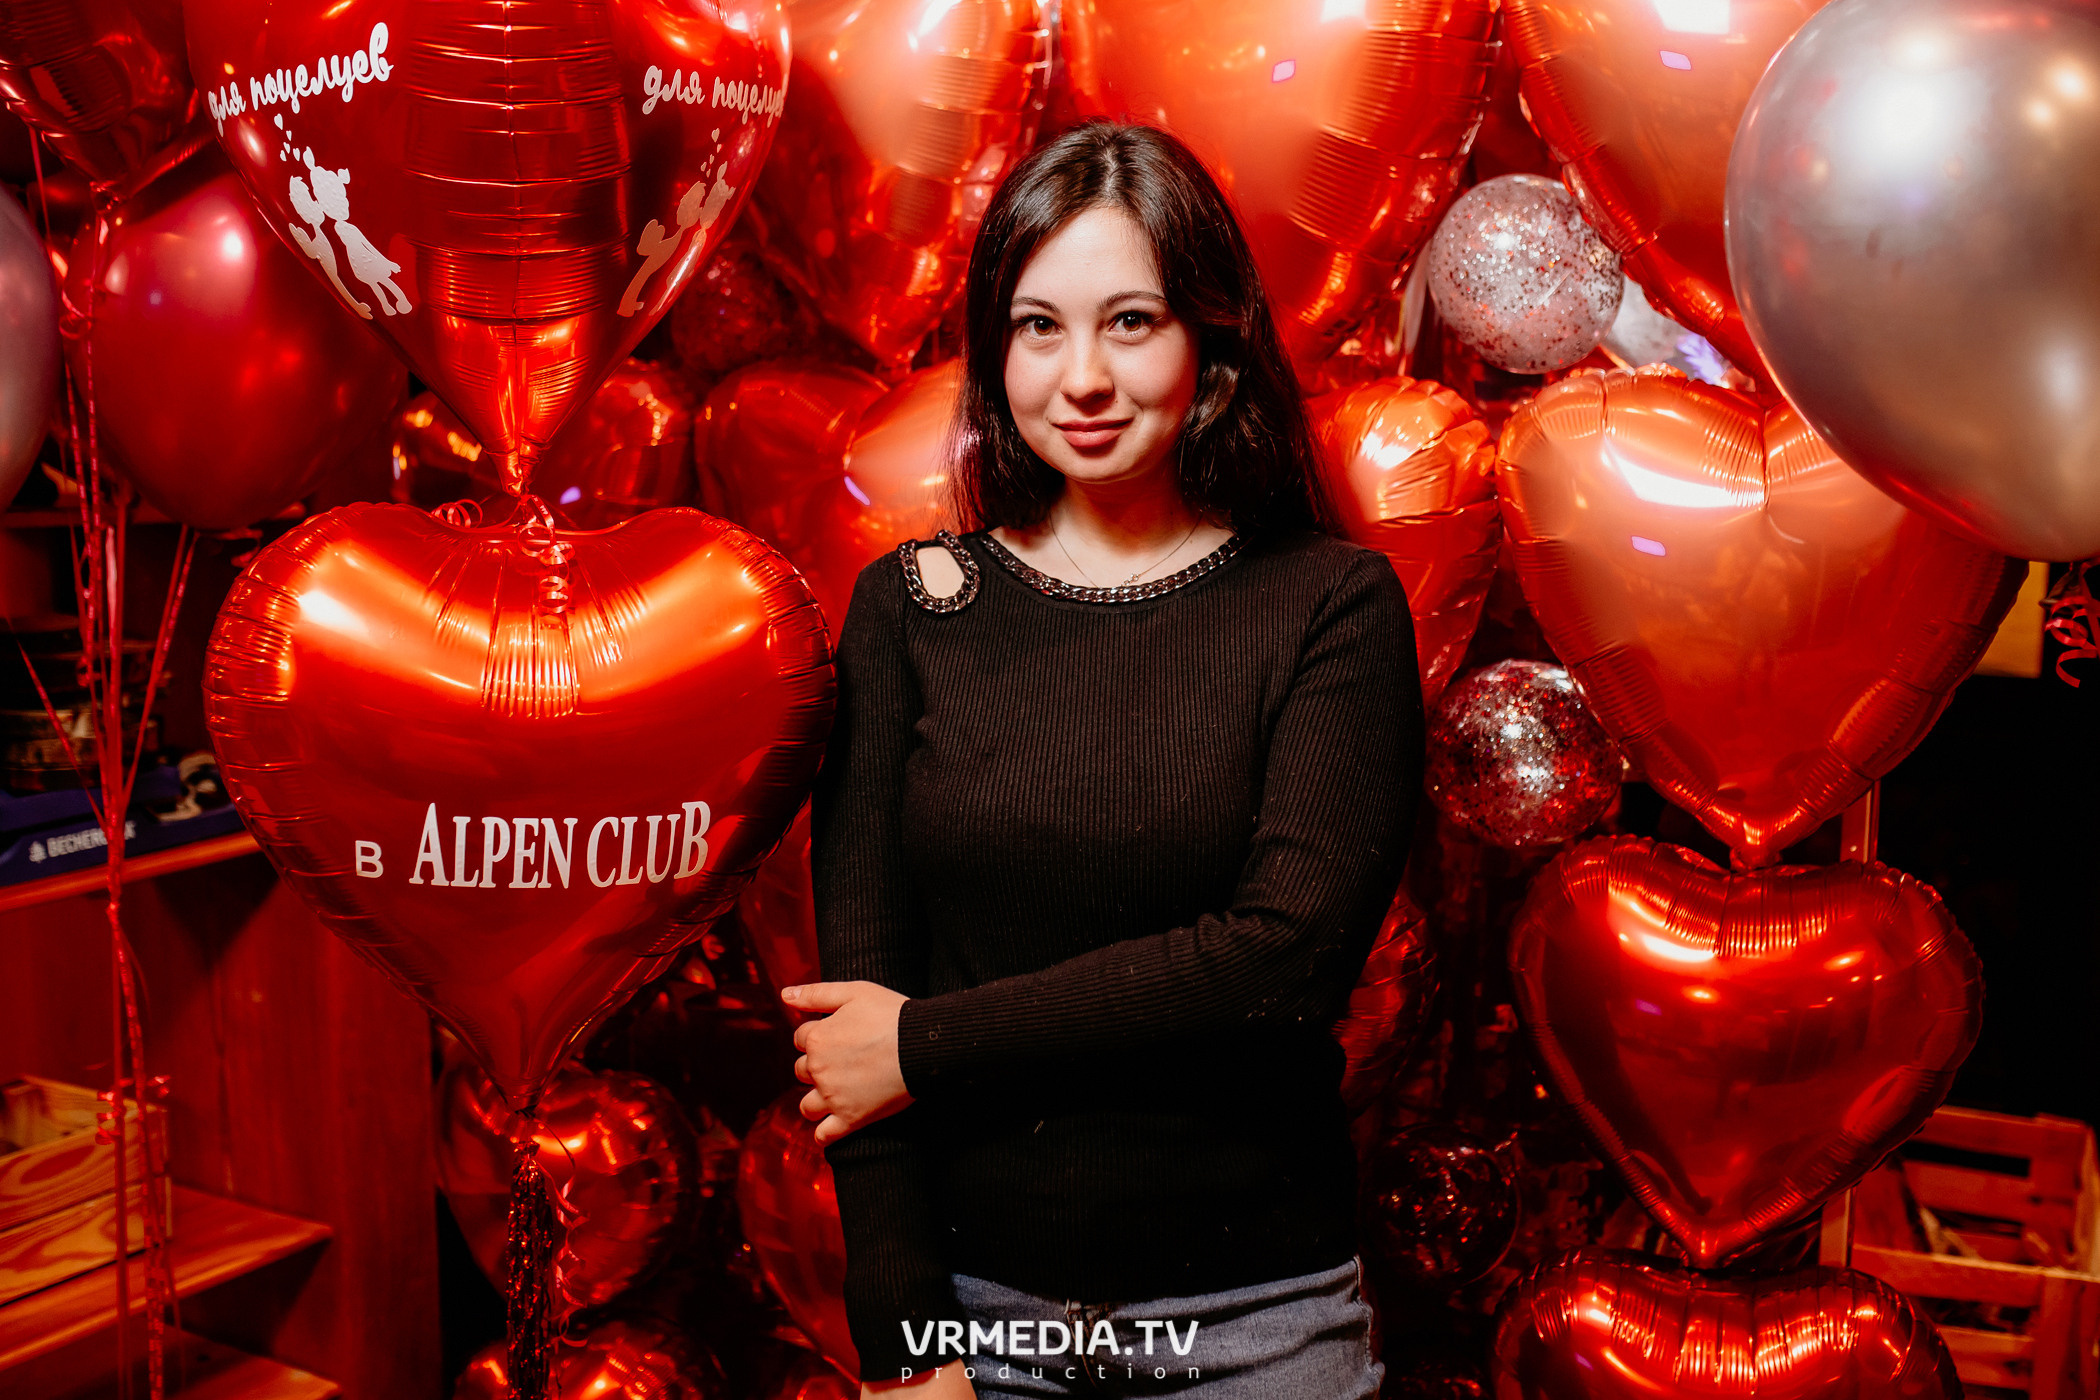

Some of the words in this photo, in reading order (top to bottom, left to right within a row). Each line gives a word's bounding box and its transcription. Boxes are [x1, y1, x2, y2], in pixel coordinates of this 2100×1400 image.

[208, 81, 246, 137] для
[250, 22, 394, 114] поцелуев
[642, 65, 705, 115] для
[409, 802, 578, 888] ALPEN
[586, 801, 711, 887] CLUB
